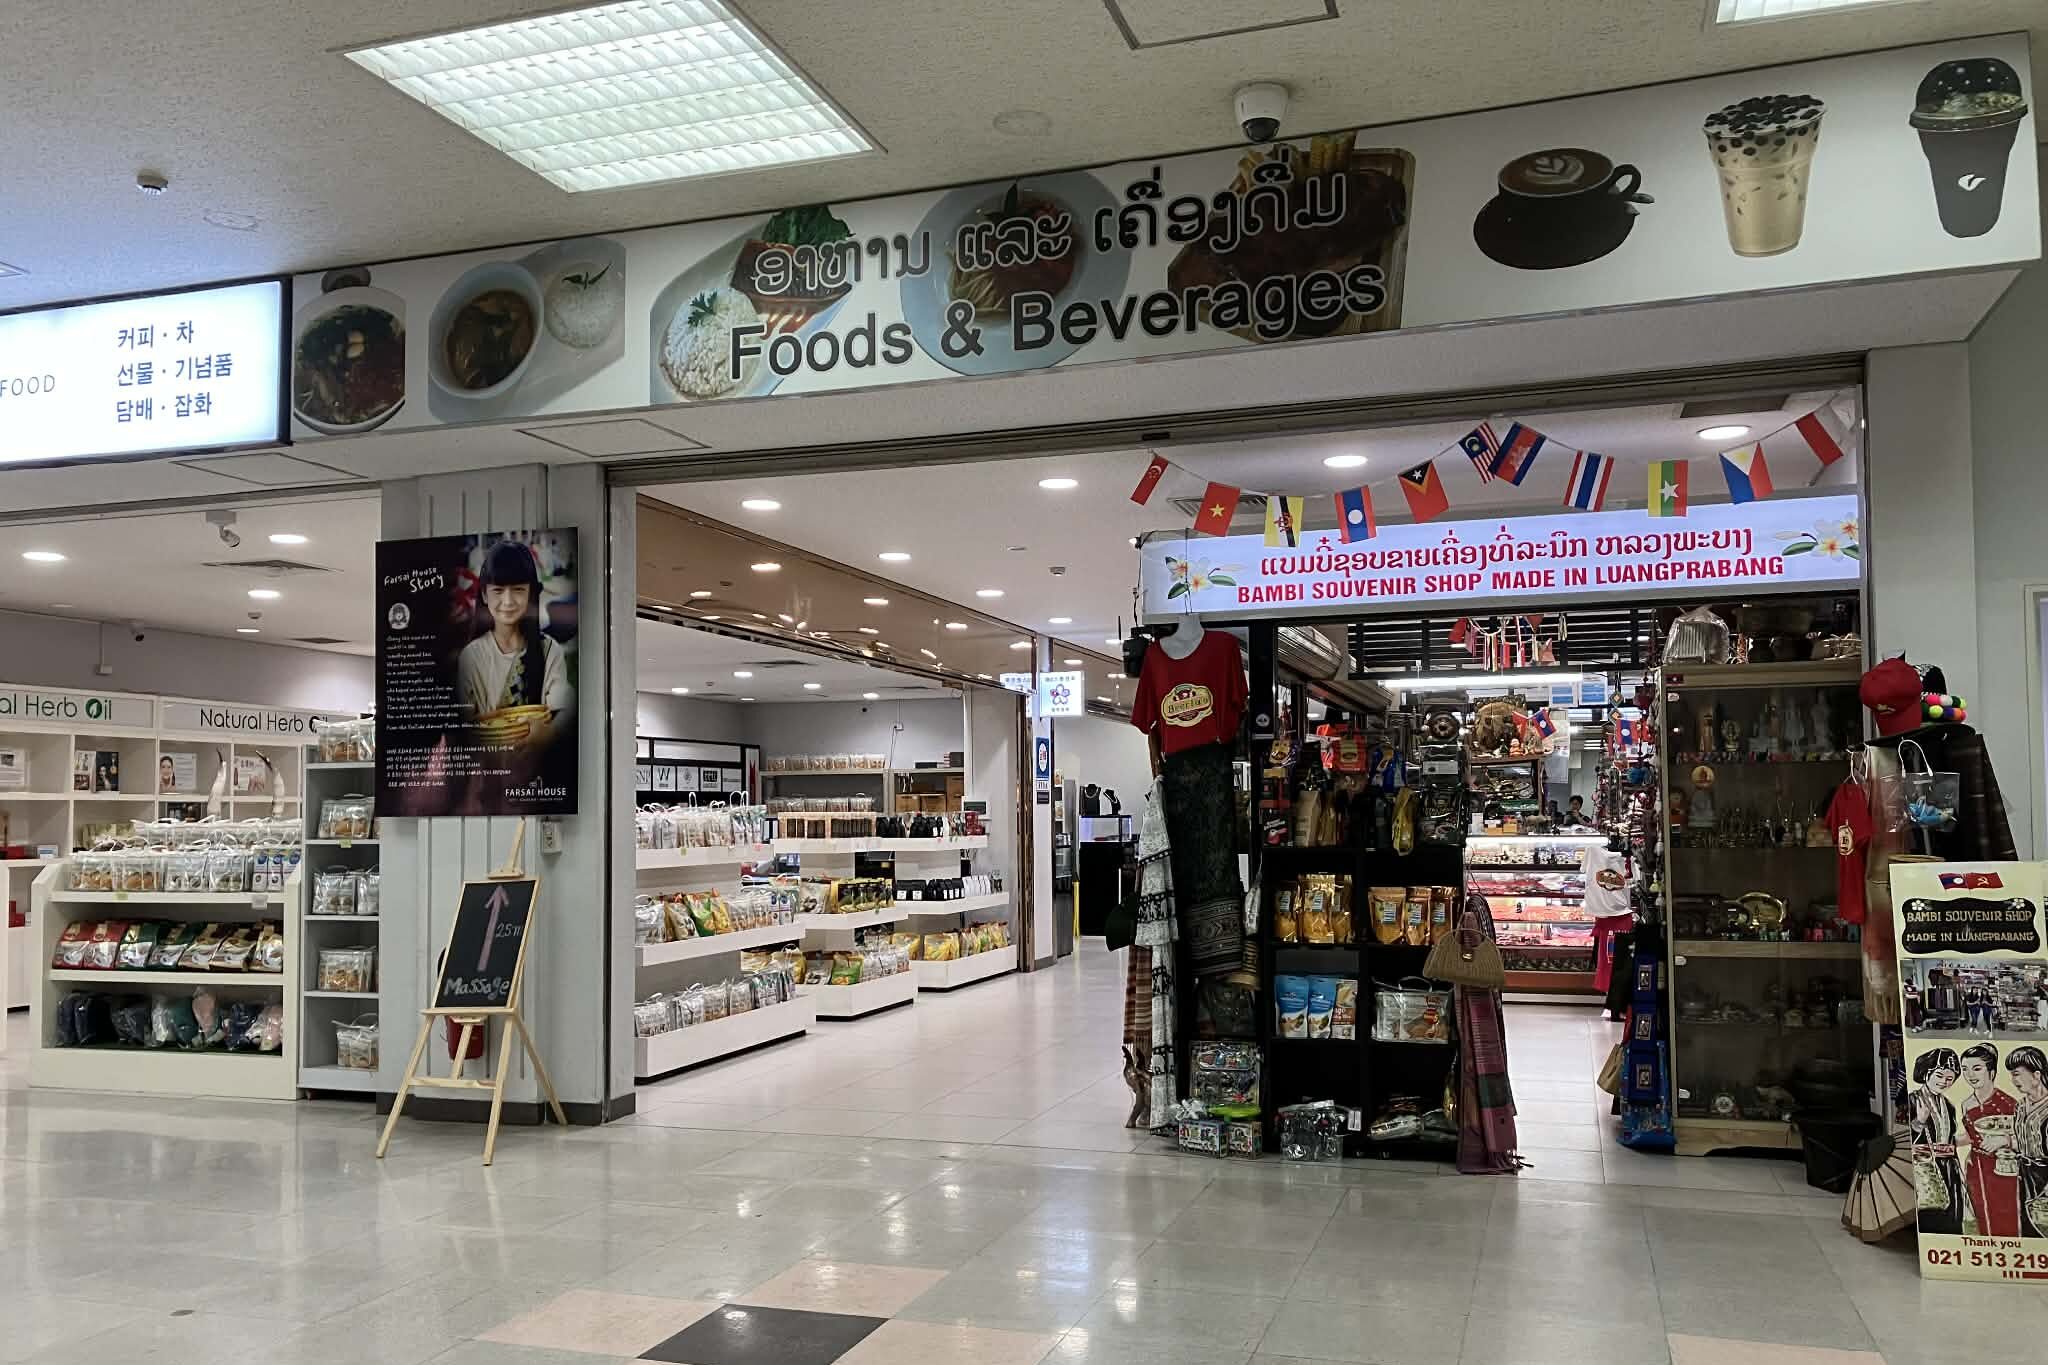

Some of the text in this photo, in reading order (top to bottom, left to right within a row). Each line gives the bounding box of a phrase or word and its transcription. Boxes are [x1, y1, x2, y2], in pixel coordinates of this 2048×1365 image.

[755, 145, 1347, 295] ອາຫານ ແລະ ເຄື່ອງດື່ມ
[729, 264, 1386, 380] Foods & Beverages
[117, 324, 154, 350] 커피
[176, 320, 194, 344] 차
[117, 361, 153, 386] 선물
[175, 353, 233, 380] 기념품
[0, 374, 56, 397] FOOD
[116, 397, 153, 423] 담배
[175, 391, 212, 418] 잡화
[410, 575, 443, 593] Story
[1238, 556, 1784, 603] BAMBI SOUVENIR SHOP MADE IN LUANGPRABANG
[26, 695, 77, 718] Herb
[85, 698, 112, 720] Oil
[200, 707, 262, 730] Natural
[267, 712, 304, 732] Herb
[505, 787, 567, 797] FARSAI HOUSE
[1907, 911, 2033, 922] BAMBI SOUVENIR SHOP
[1906, 931, 2035, 942] MADE IN LUANGPRABANG
[443, 976, 510, 1001] Massage
[1961, 1236, 2022, 1250] Thank you
[1927, 1249, 2048, 1270] 021 513 219
